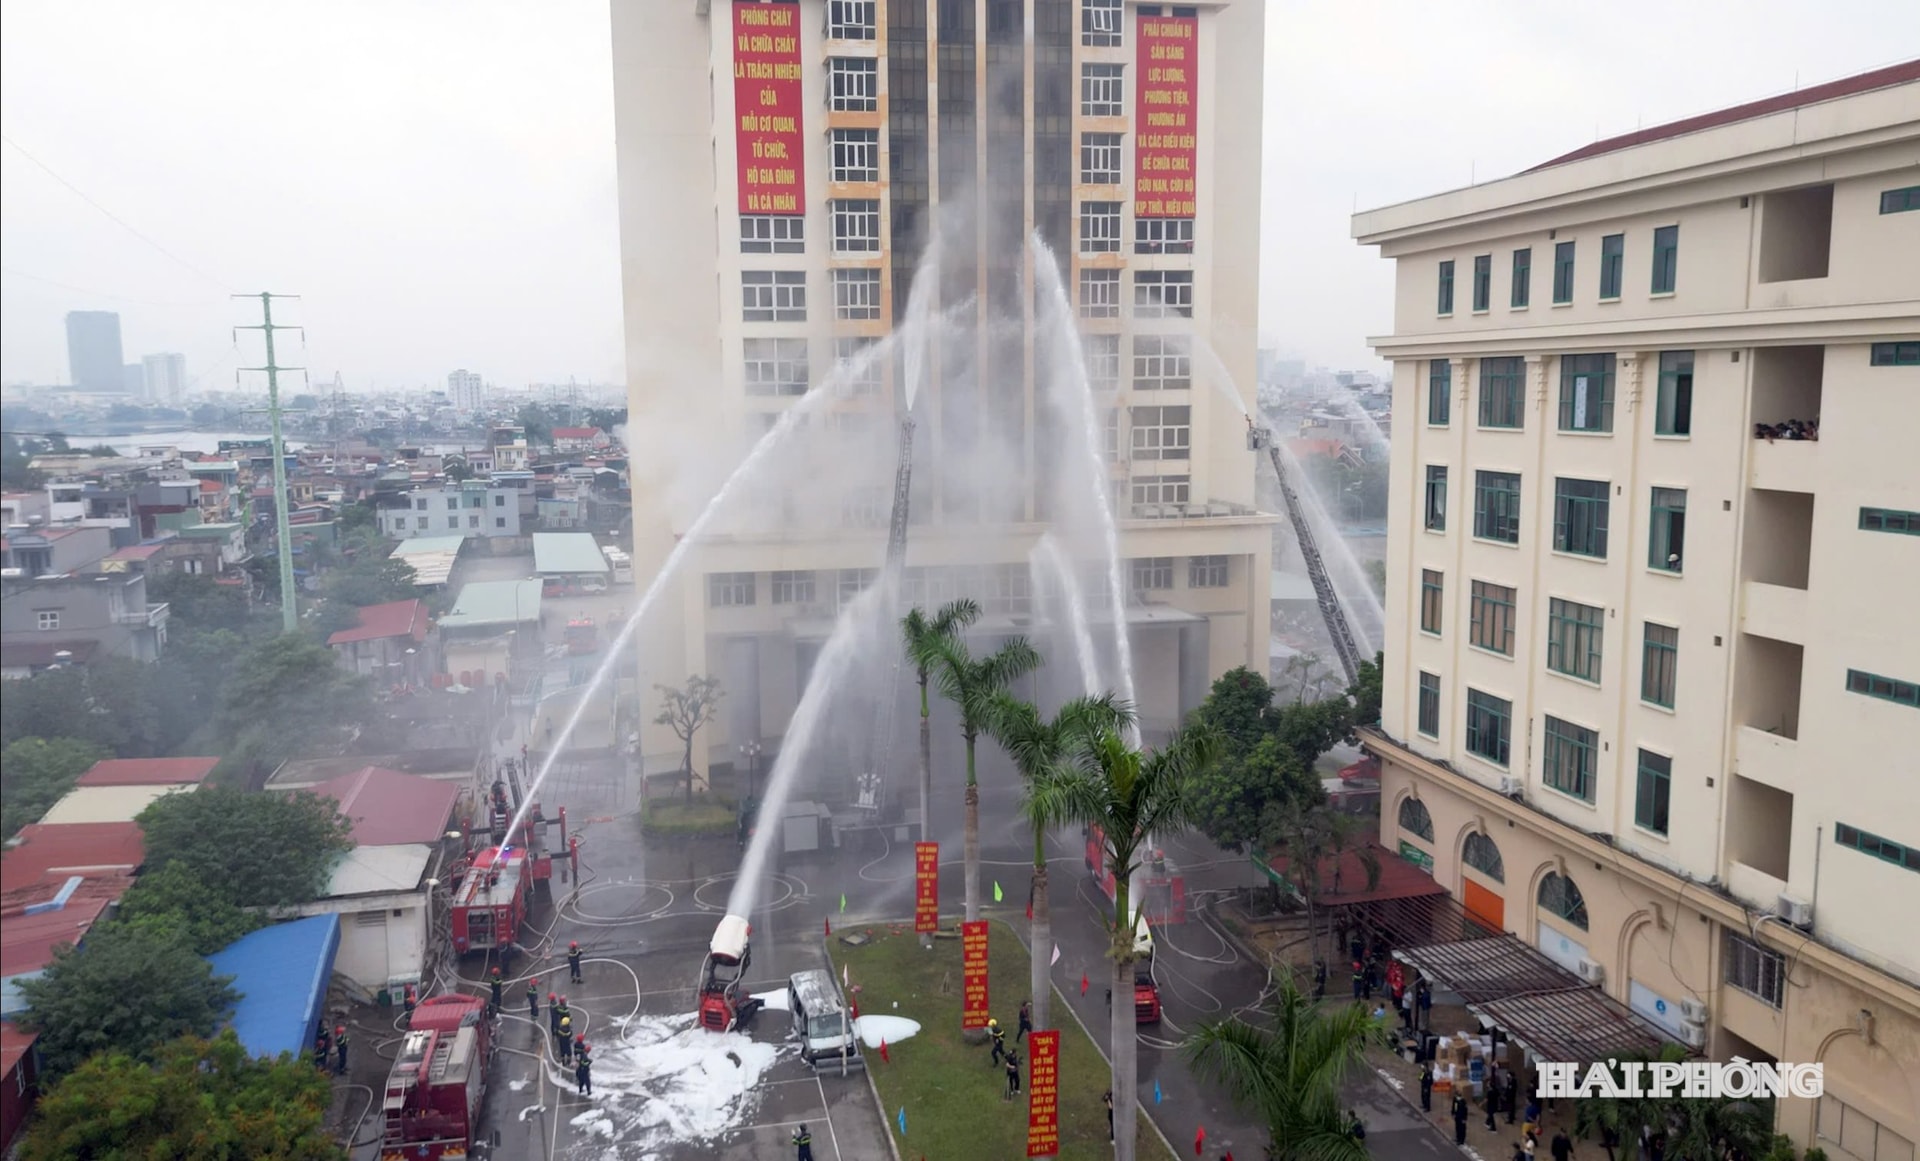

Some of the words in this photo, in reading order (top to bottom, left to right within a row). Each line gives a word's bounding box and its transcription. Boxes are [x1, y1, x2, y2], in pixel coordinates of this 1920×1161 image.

[741, 6, 769, 26] PHÒNG
[771, 8, 792, 27] CHÁY
[738, 32, 750, 52] VÀ
[751, 33, 773, 52] CHỮA
[775, 34, 796, 53] CHÁY
[735, 59, 745, 78] LÀ
[746, 60, 772, 79] TRÁCH
[775, 60, 801, 83] NHIỆM
[760, 85, 777, 106] CỦA
[760, 115, 771, 132] CƠ
[773, 116, 797, 134] QUAN,
[765, 139, 789, 160] CHỨC,
[747, 165, 758, 187] HỘ
[760, 169, 774, 184] GIA
[776, 165, 795, 184] ĐÌNH
[748, 192, 759, 210] VÀ
[760, 192, 772, 210] CÁ
[773, 192, 796, 210] NHÂN
